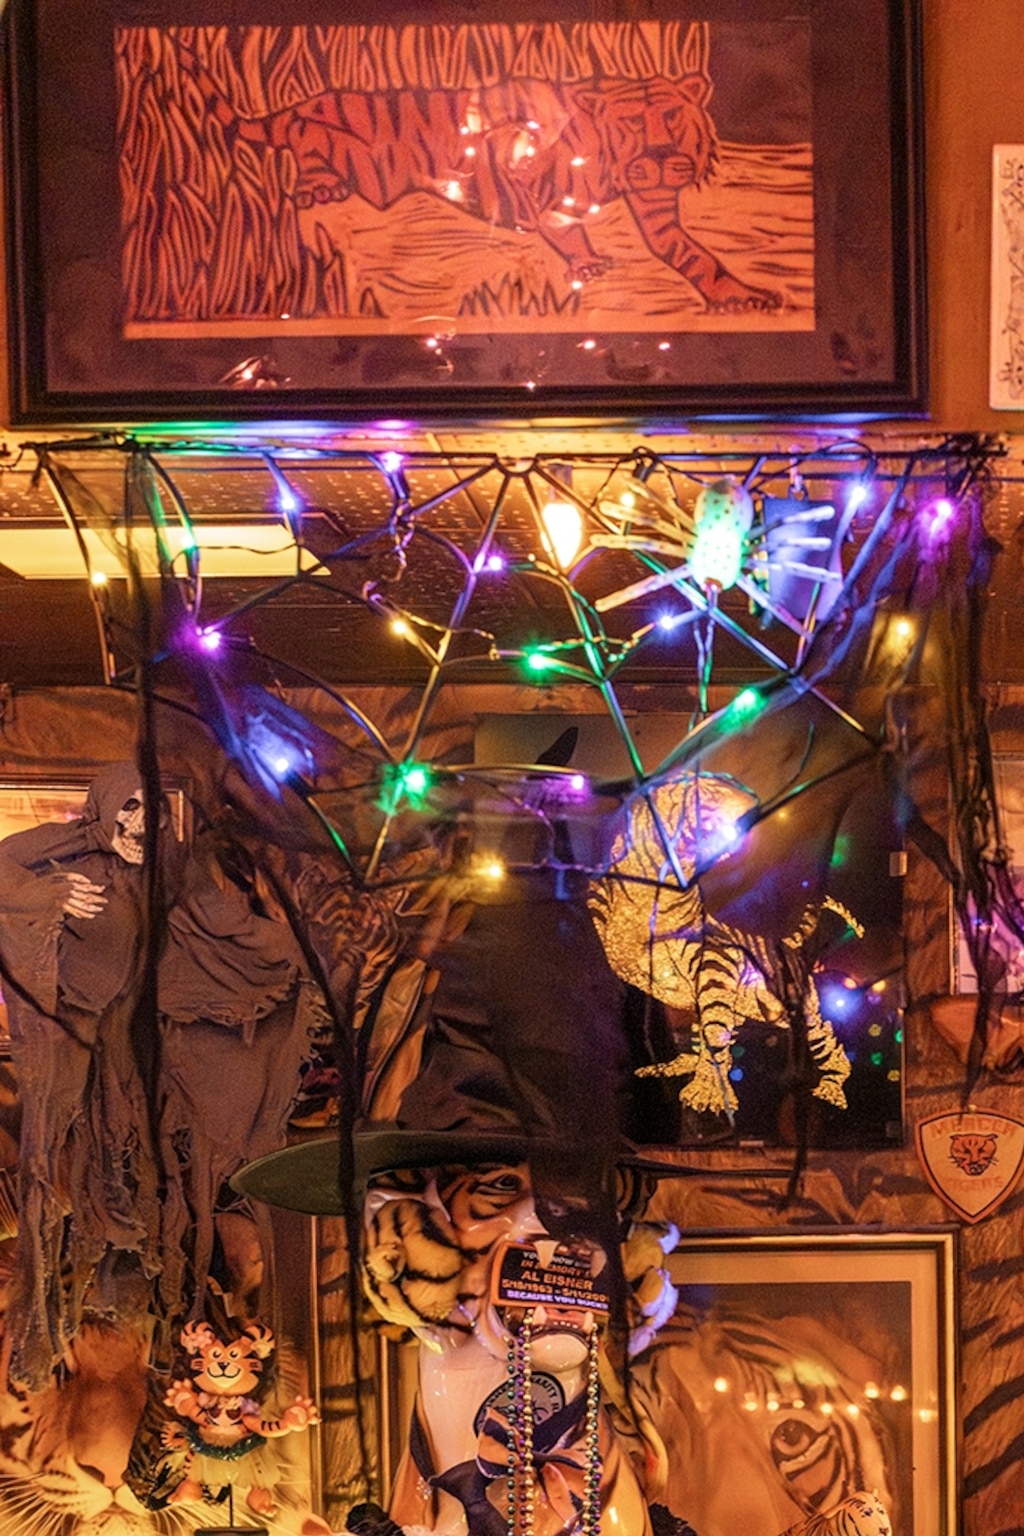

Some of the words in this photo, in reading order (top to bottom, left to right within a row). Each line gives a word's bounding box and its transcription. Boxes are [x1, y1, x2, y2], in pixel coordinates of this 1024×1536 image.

[521, 1270, 540, 1282] AL
[543, 1273, 594, 1291] EISNER
[506, 1289, 554, 1303] BECAUSE
[554, 1294, 576, 1305] YOU
